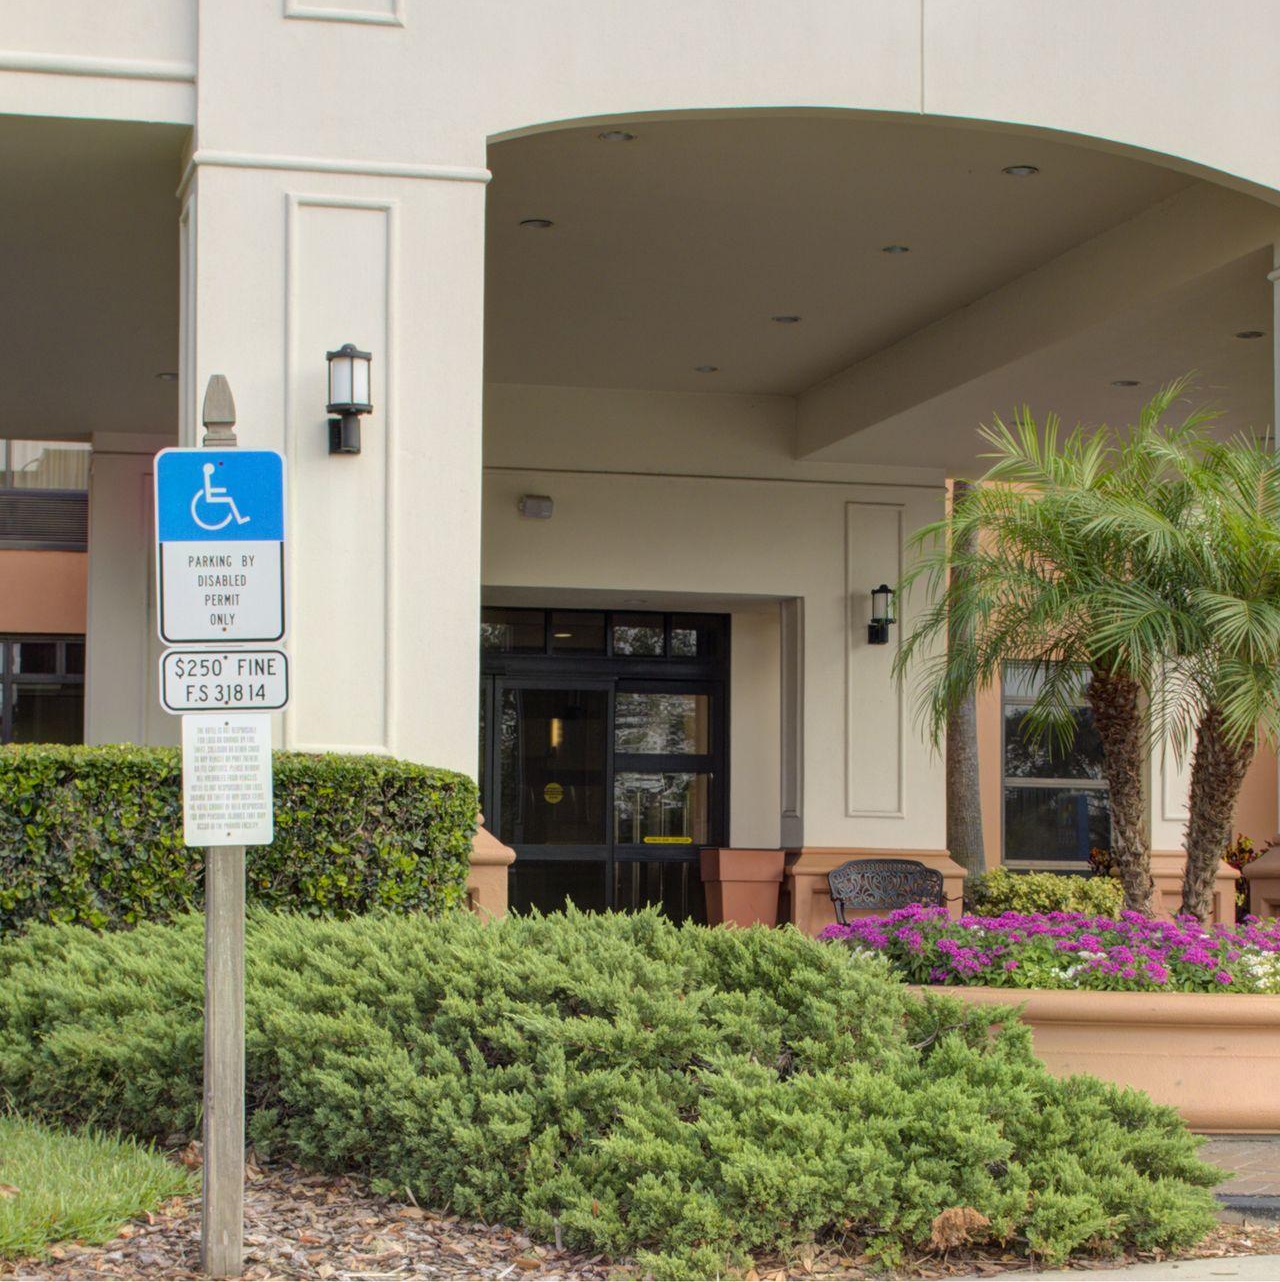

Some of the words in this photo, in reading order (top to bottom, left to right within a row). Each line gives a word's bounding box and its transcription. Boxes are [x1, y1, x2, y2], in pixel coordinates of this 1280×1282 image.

[188, 555, 232, 568] PARKING
[241, 555, 255, 567] BY
[197, 574, 247, 587] DISABLED
[204, 594, 240, 606] PERMIT
[210, 614, 235, 626] ONLY
[175, 658, 222, 679] $250
[238, 658, 276, 676] FINE
